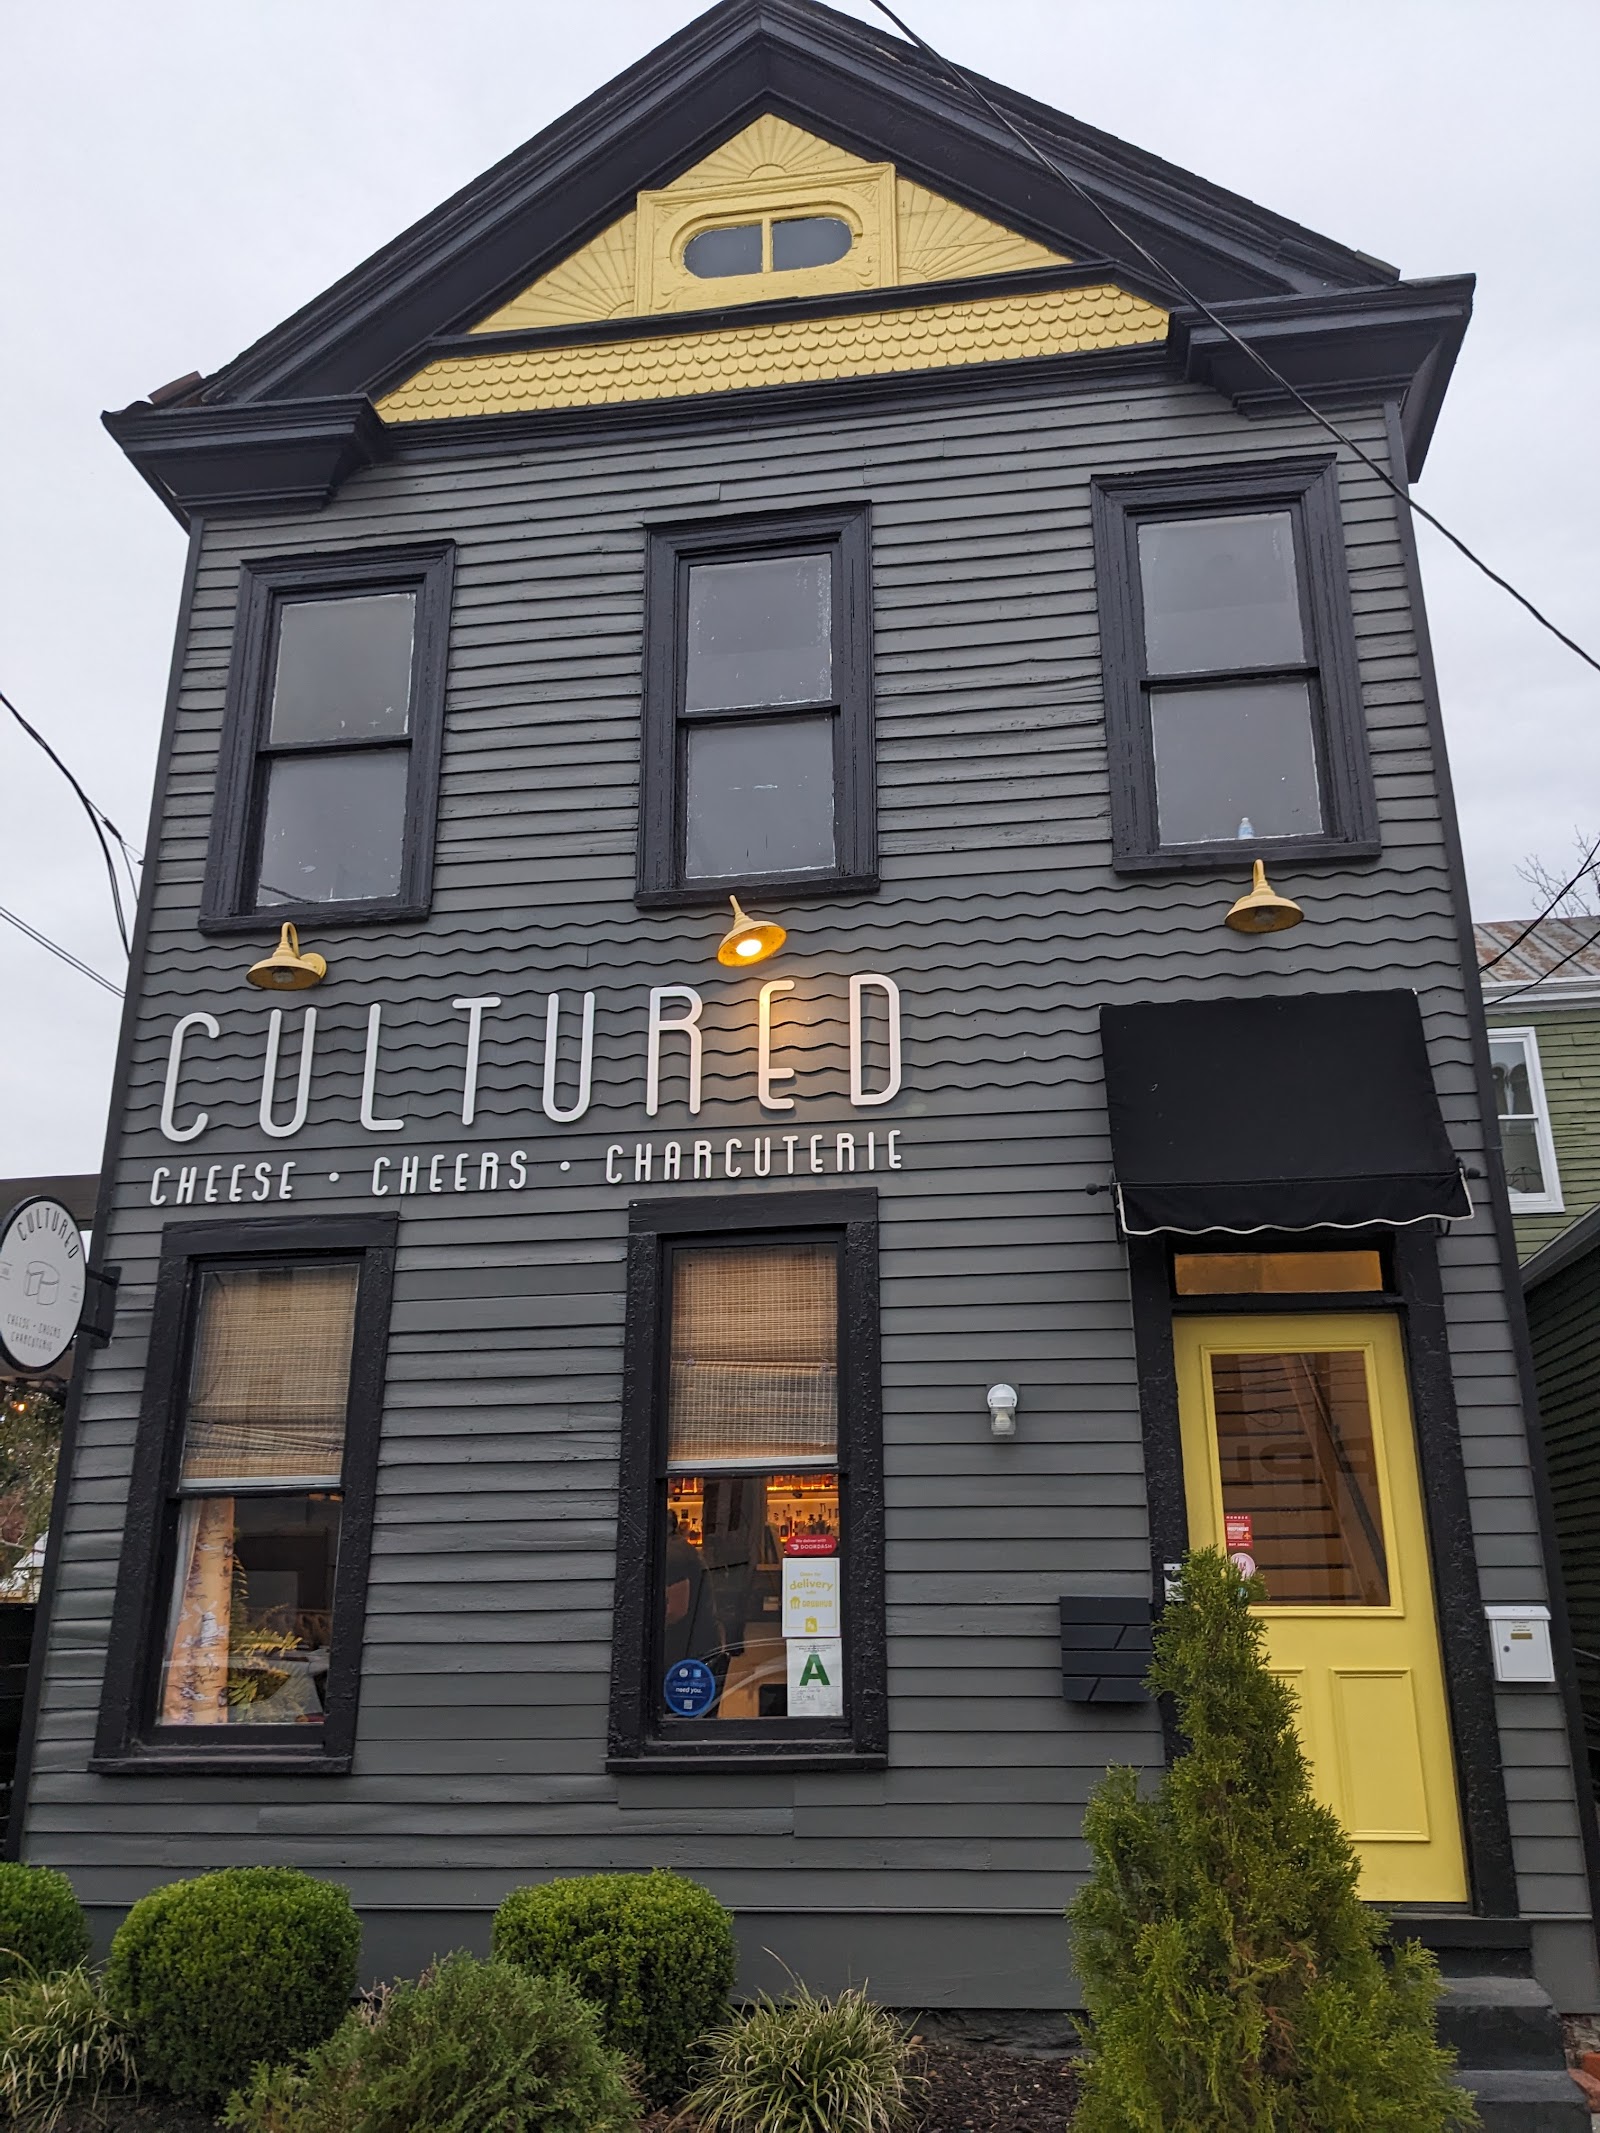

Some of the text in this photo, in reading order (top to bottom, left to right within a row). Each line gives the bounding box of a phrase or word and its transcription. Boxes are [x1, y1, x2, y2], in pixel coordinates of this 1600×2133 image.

[160, 973, 902, 1142] CULTURED
[149, 1129, 903, 1206] CHEESE CHEERS CHARCUTERIE
[17, 1207, 79, 1259] CULTURED
[790, 1578, 833, 1592] delivery
[675, 1686, 690, 1694] need
[799, 1654, 831, 1686] A
